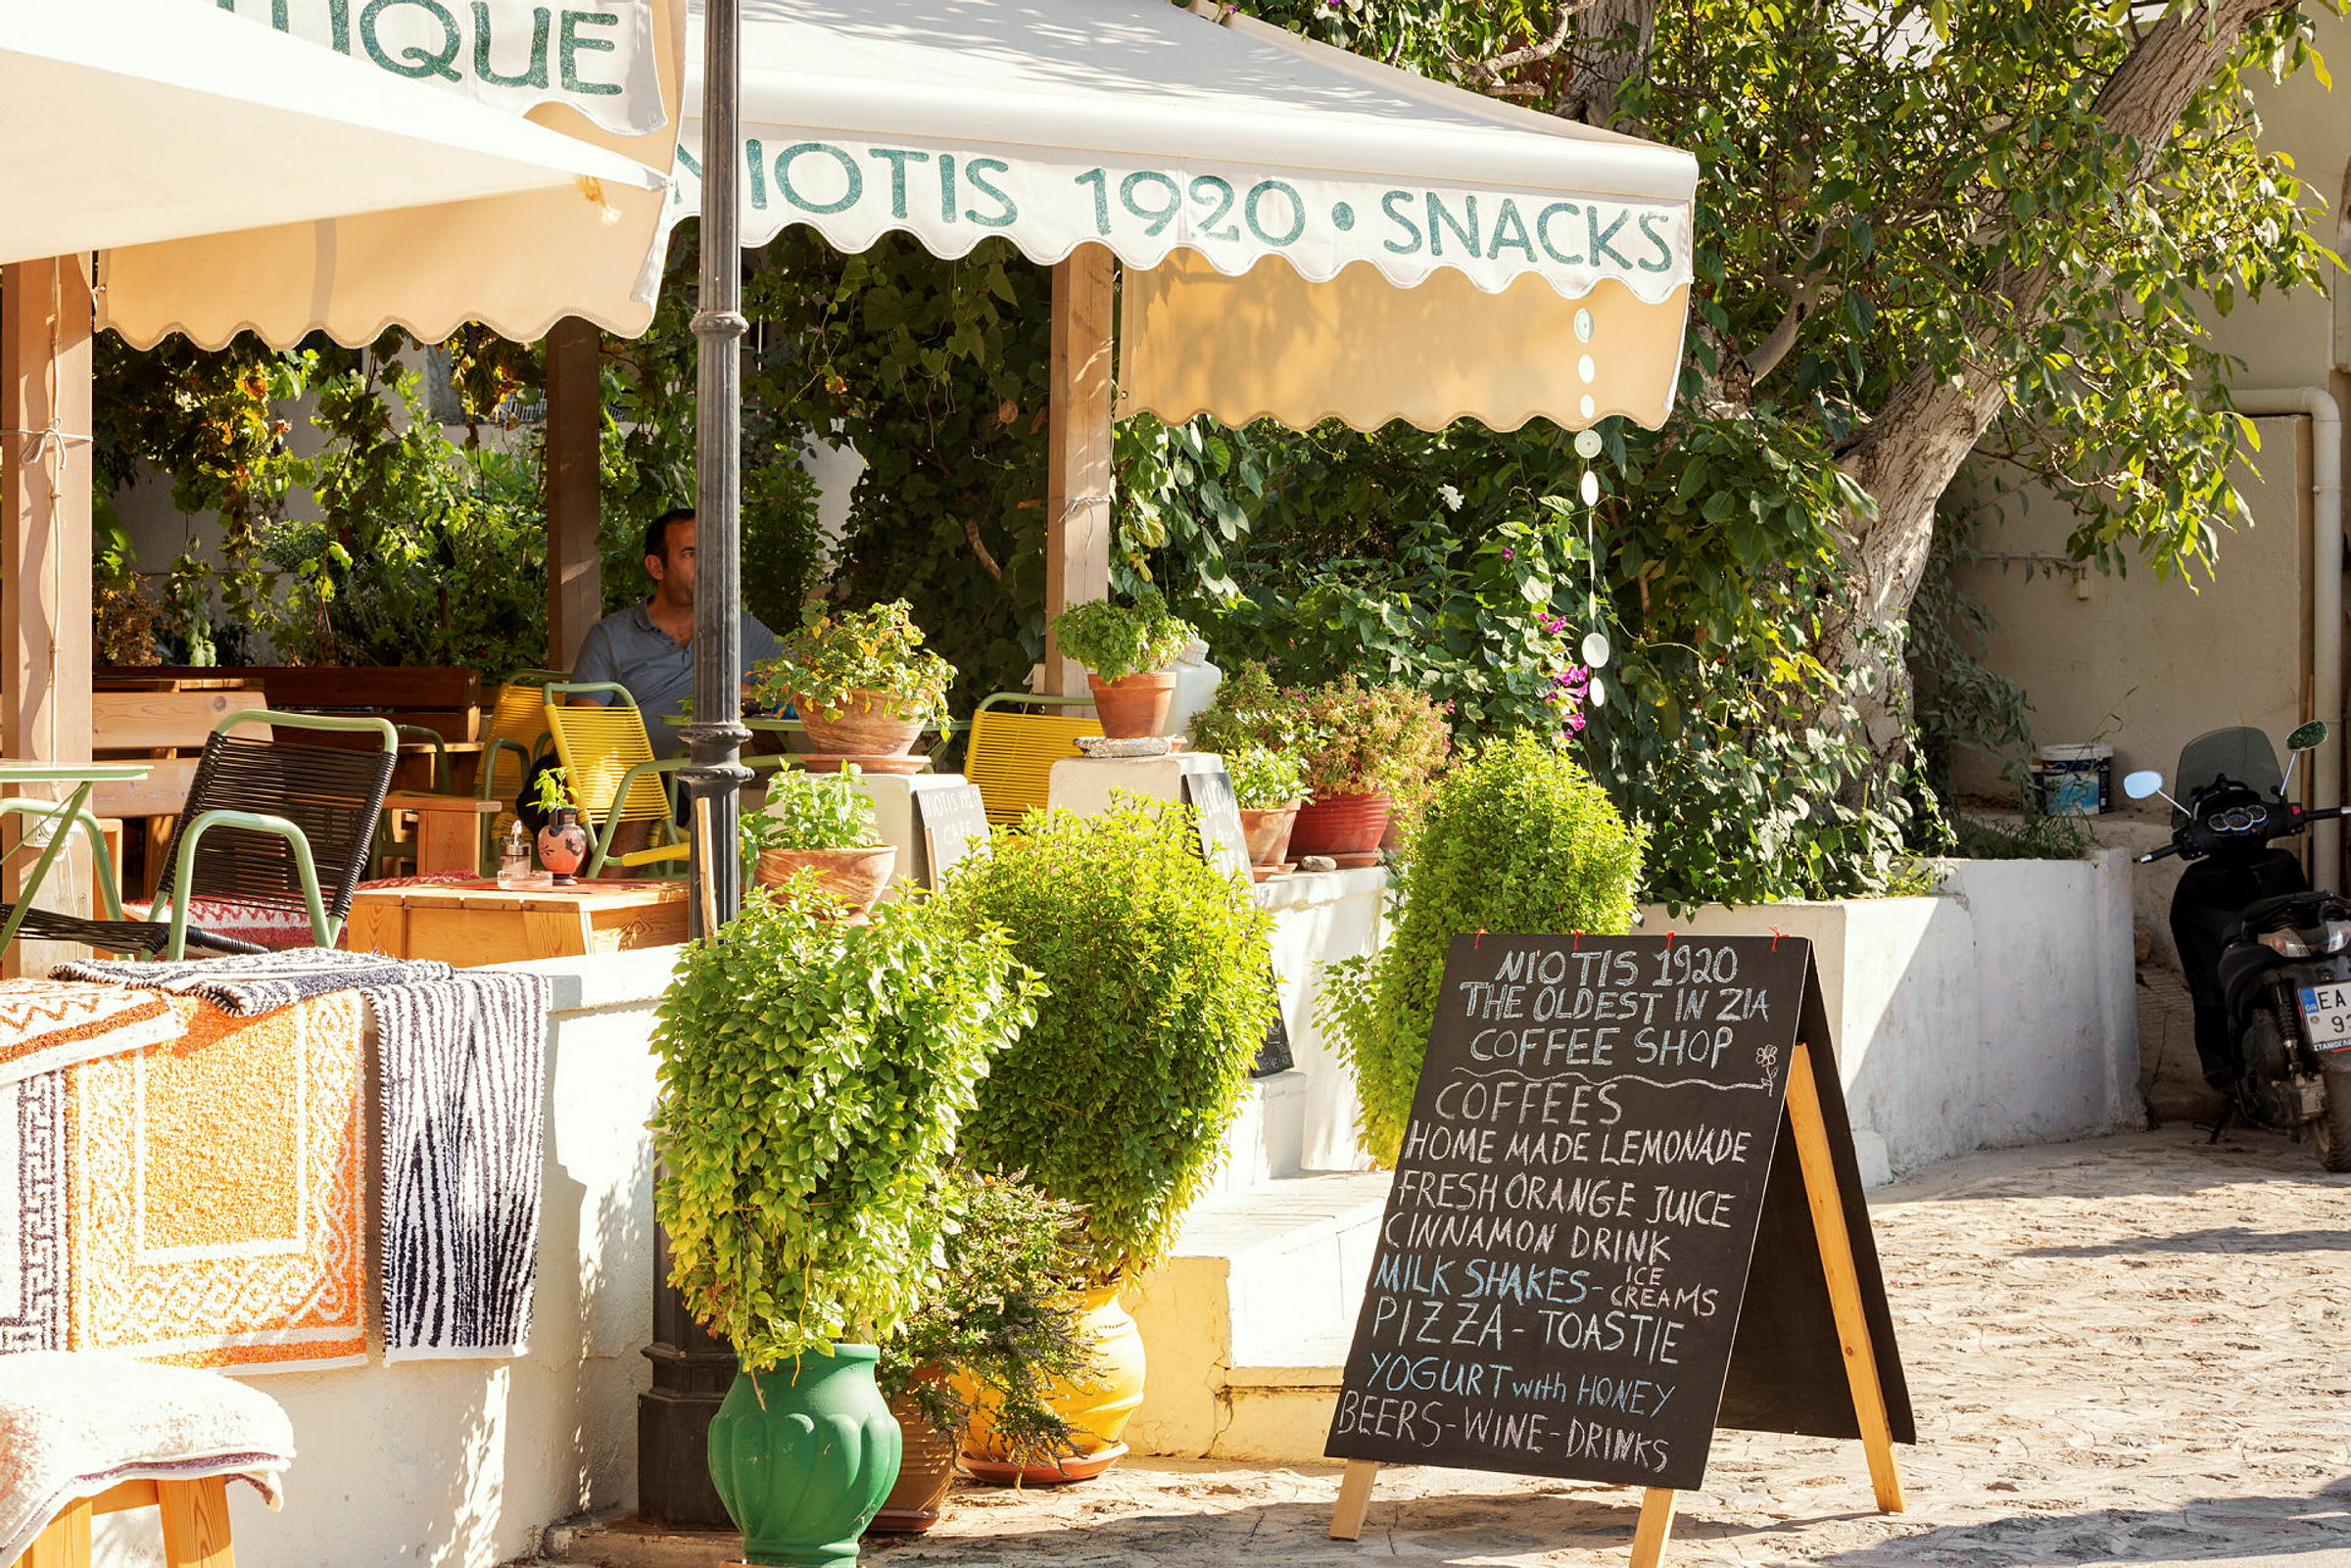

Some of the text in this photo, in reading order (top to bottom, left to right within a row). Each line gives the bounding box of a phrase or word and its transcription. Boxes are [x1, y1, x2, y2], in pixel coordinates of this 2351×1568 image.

[216, 0, 623, 94] IQUE
[1075, 166, 1306, 247] 1920
[1381, 190, 1673, 273] SNACKS
[1653, 944, 1740, 986] 1920
[1460, 981, 1771, 1024] THE OLDEST IN ZIA
[2318, 989, 2346, 1010] EA
[1470, 1026, 1734, 1069] COFFEE SHOP
[1435, 1081, 1623, 1125] COFFEES
[1404, 1119, 1752, 1166] HOME MADE LEMONADE
[1399, 1169, 1737, 1228] FRESH ORANGE JUICE
[1384, 1212, 1671, 1266] CINNAMON DRINK
[1373, 1253, 1457, 1297] MILK
[1626, 1265, 1665, 1286] ICE
[1609, 1283, 1719, 1317] CREAMS
[1538, 1310, 1685, 1364] TOASTIE
[1367, 1353, 1676, 1418] YOGURT with HONEY
